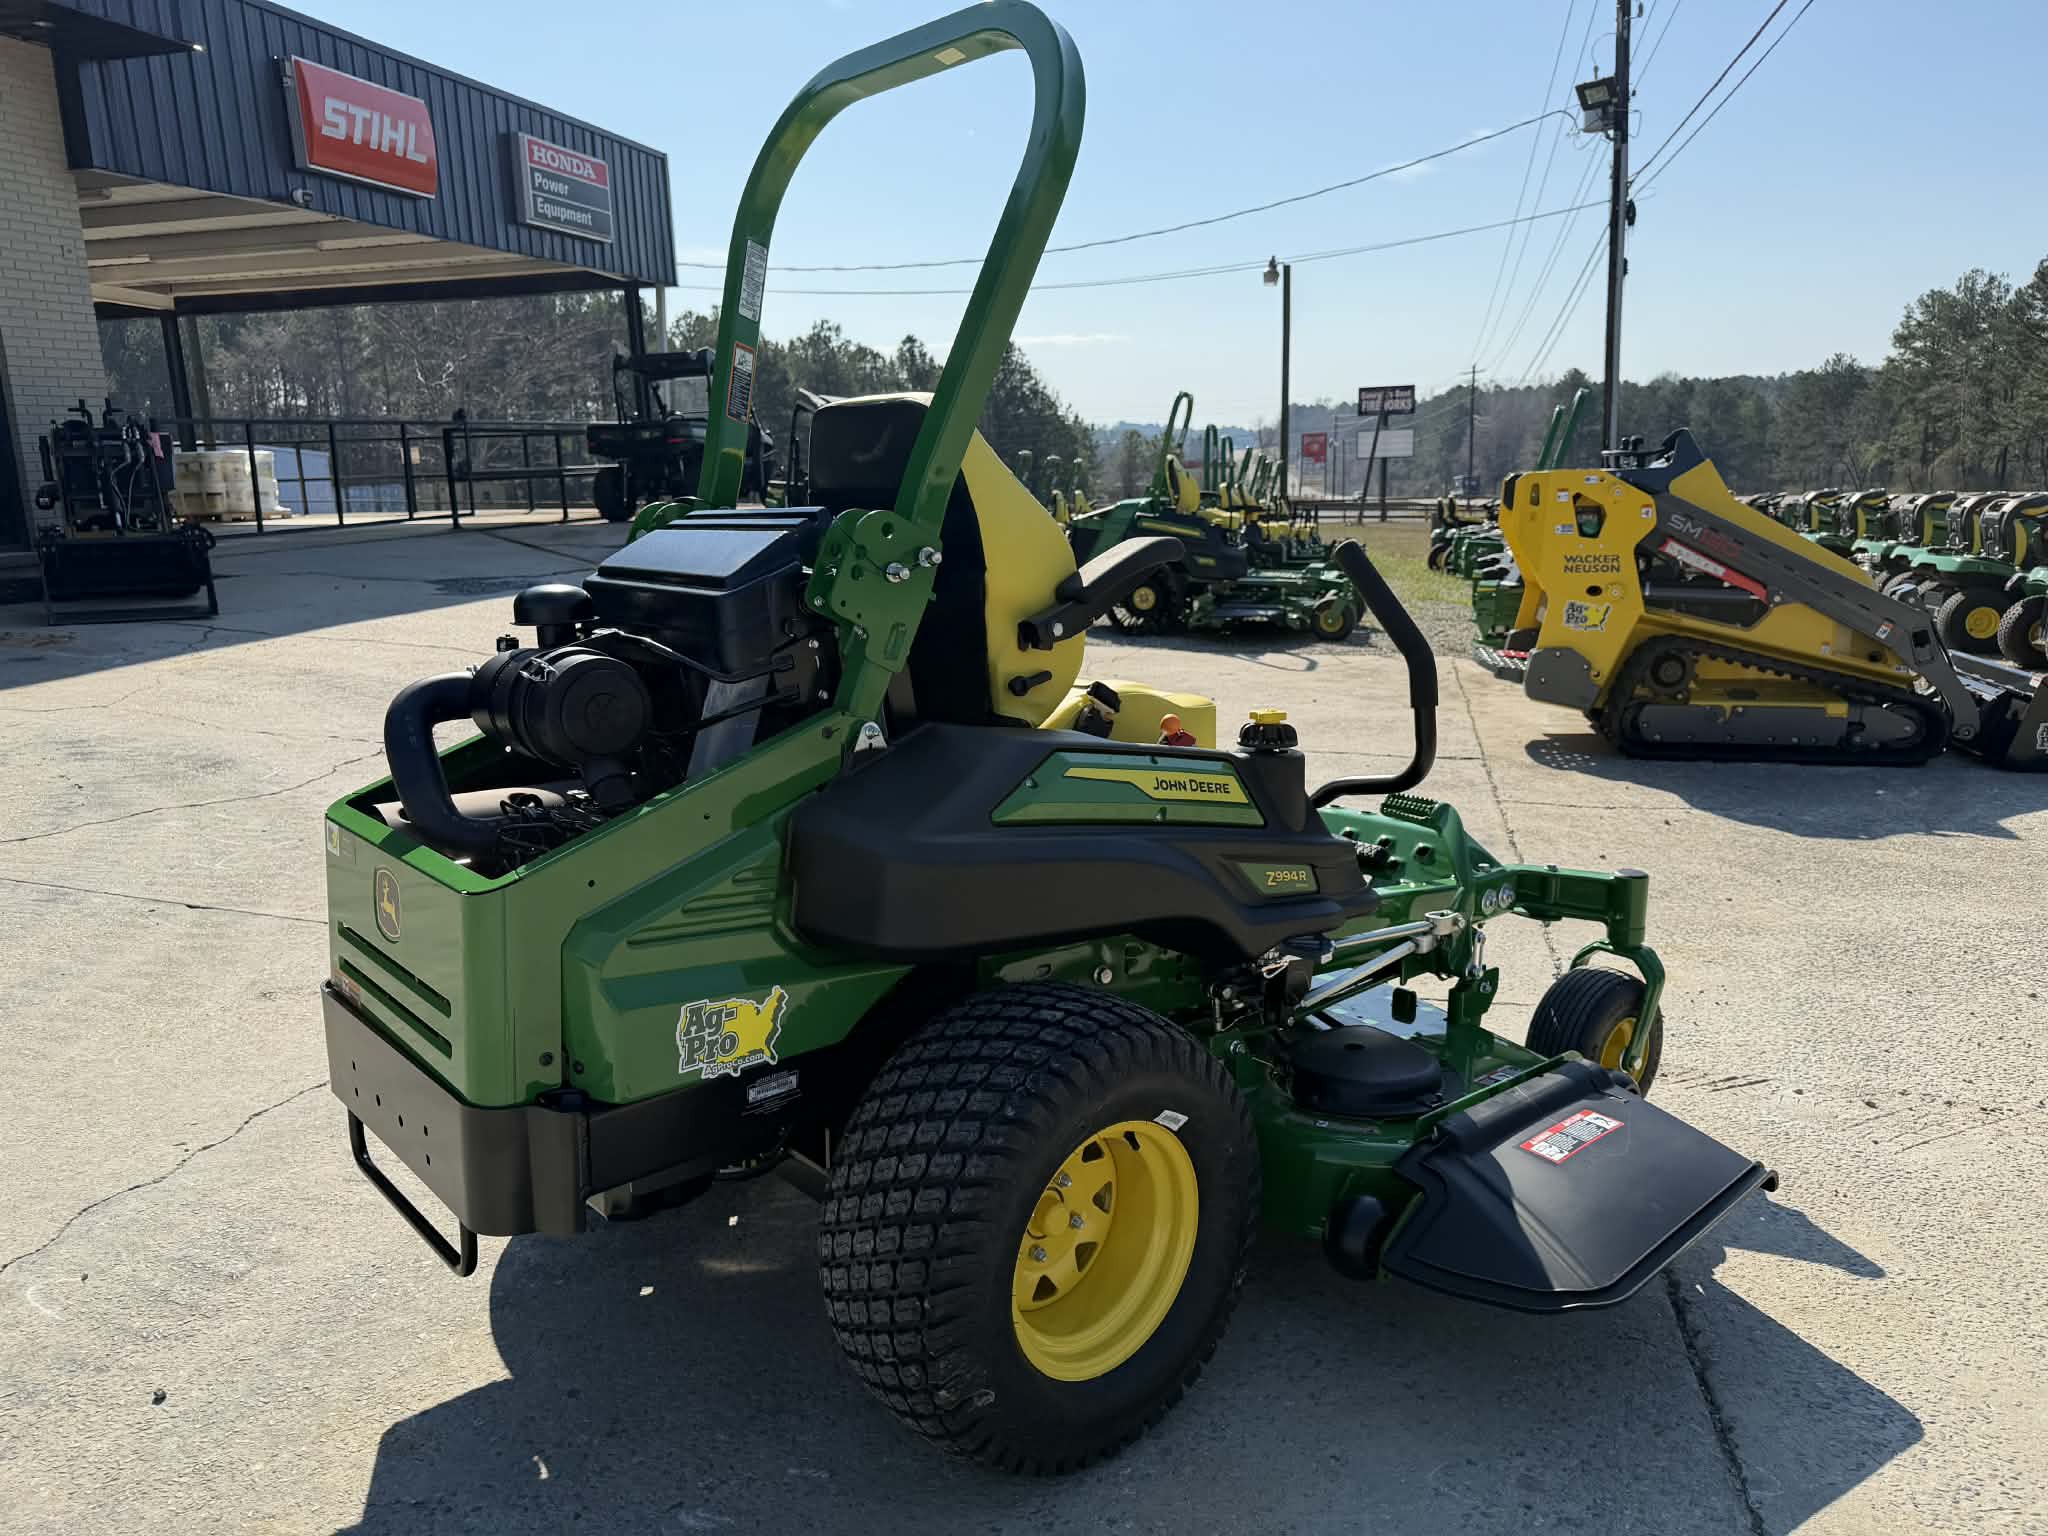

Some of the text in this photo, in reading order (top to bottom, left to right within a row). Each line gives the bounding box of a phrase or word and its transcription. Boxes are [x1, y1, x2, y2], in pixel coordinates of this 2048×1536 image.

[321, 95, 428, 164] STIHL
[531, 143, 597, 180] HONDA
[534, 171, 569, 197] Power
[536, 196, 593, 226] Equipment
[1563, 554, 1621, 564] WACKER
[1563, 564, 1621, 574] NEUSON
[1566, 613, 1588, 625] Pro
[1153, 776, 1231, 794] JOHN DEERE
[1265, 870, 1307, 887] Z994R
[681, 1003, 738, 1038] Ag-
[682, 1031, 740, 1070] Pro
[704, 1052, 766, 1076] AgProCo.com
